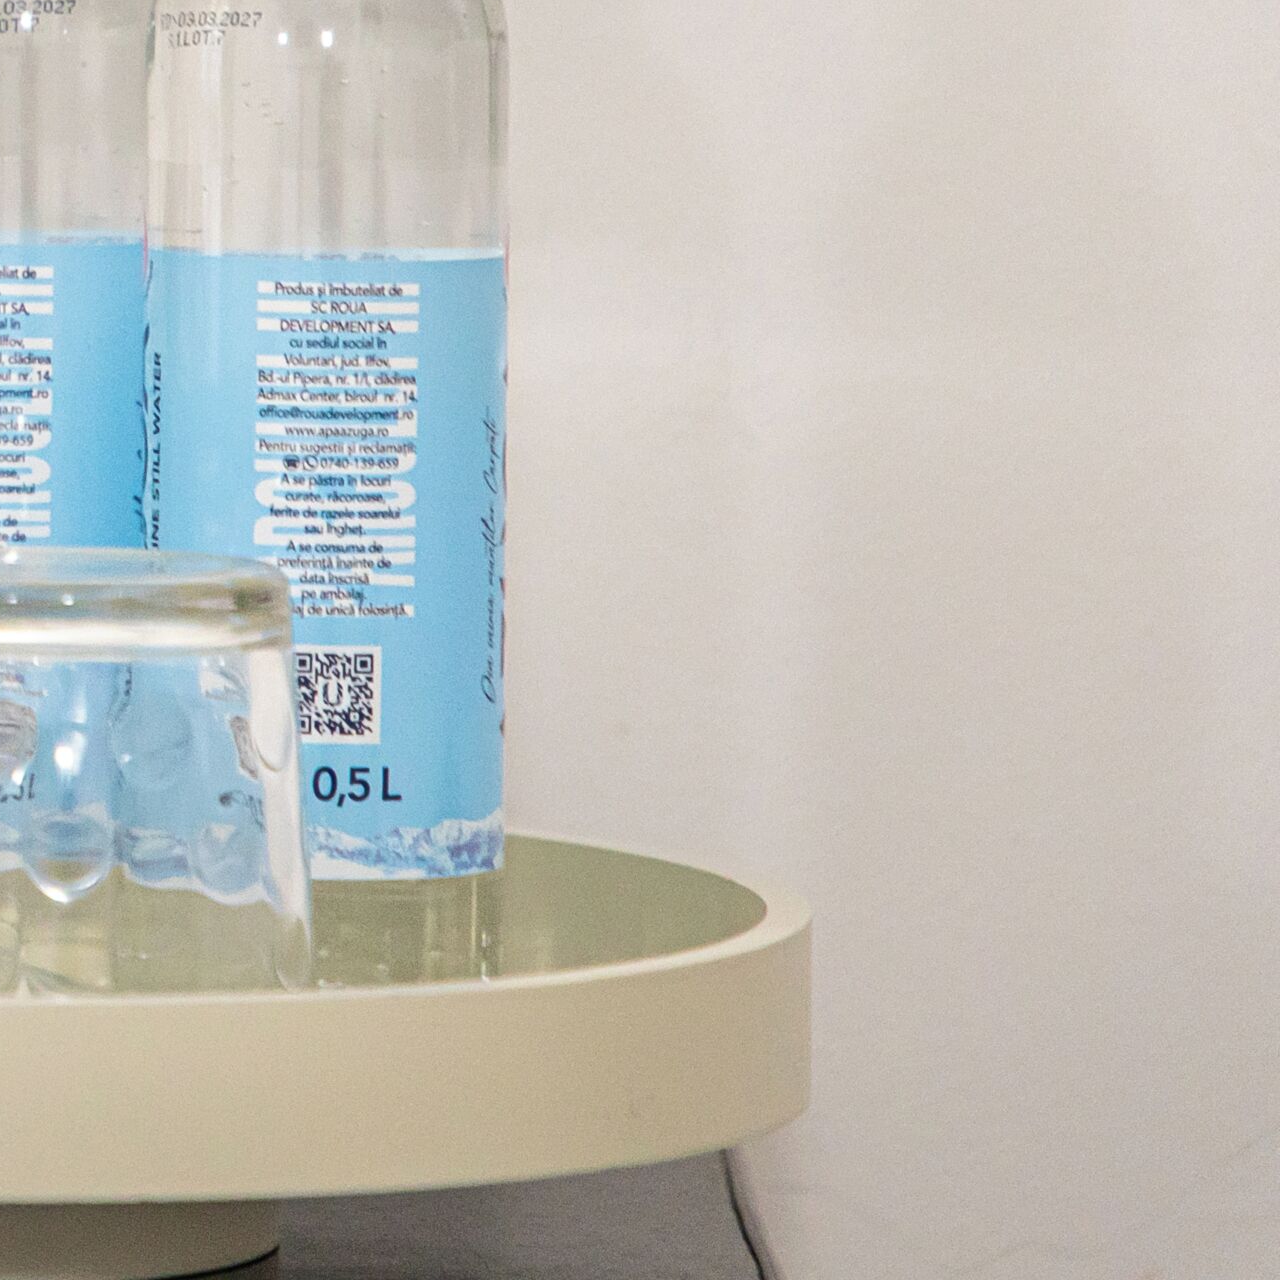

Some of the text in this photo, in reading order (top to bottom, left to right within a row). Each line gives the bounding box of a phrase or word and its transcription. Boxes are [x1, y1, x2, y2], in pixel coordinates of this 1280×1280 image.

[22, 267, 37, 280] de
[275, 281, 313, 296] Produs
[389, 284, 403, 296] de
[311, 301, 367, 314] SC ROUA
[280, 319, 374, 333] DEVELOPMENT
[290, 339, 302, 348] cu
[306, 336, 339, 348] sediul
[342, 338, 374, 349] social
[341, 355, 360, 370] jud.
[18, 373, 32, 381] nr.
[293, 372, 333, 387] Pipera,
[336, 377, 350, 385] nr.
[152, 353, 161, 435] WATER
[257, 388, 296, 401] Admax
[301, 390, 340, 404] Center,
[345, 390, 377, 402] biroul
[384, 393, 398, 402] nr.
[259, 405, 413, 423] office@rouadevelopment.ro
[285, 426, 389, 439] www.apaazuga.ro
[259, 439, 296, 452] Pentru
[300, 441, 343, 455] sugestii
[152, 443, 161, 501] STILL
[281, 474, 289, 485] A
[293, 476, 305, 485] se
[361, 475, 391, 486] locuri
[270, 505, 400, 519] ferite de razele soarelui
[3, 514, 18, 527] de
[305, 524, 322, 534] sau
[11, 531, 26, 542] de
[287, 540, 383, 554] A se consuma de
[377, 558, 391, 569] de
[300, 573, 325, 584] data
[301, 591, 316, 604] pe
[308, 604, 322, 615] de
[313, 766, 402, 807] 0,5 L
